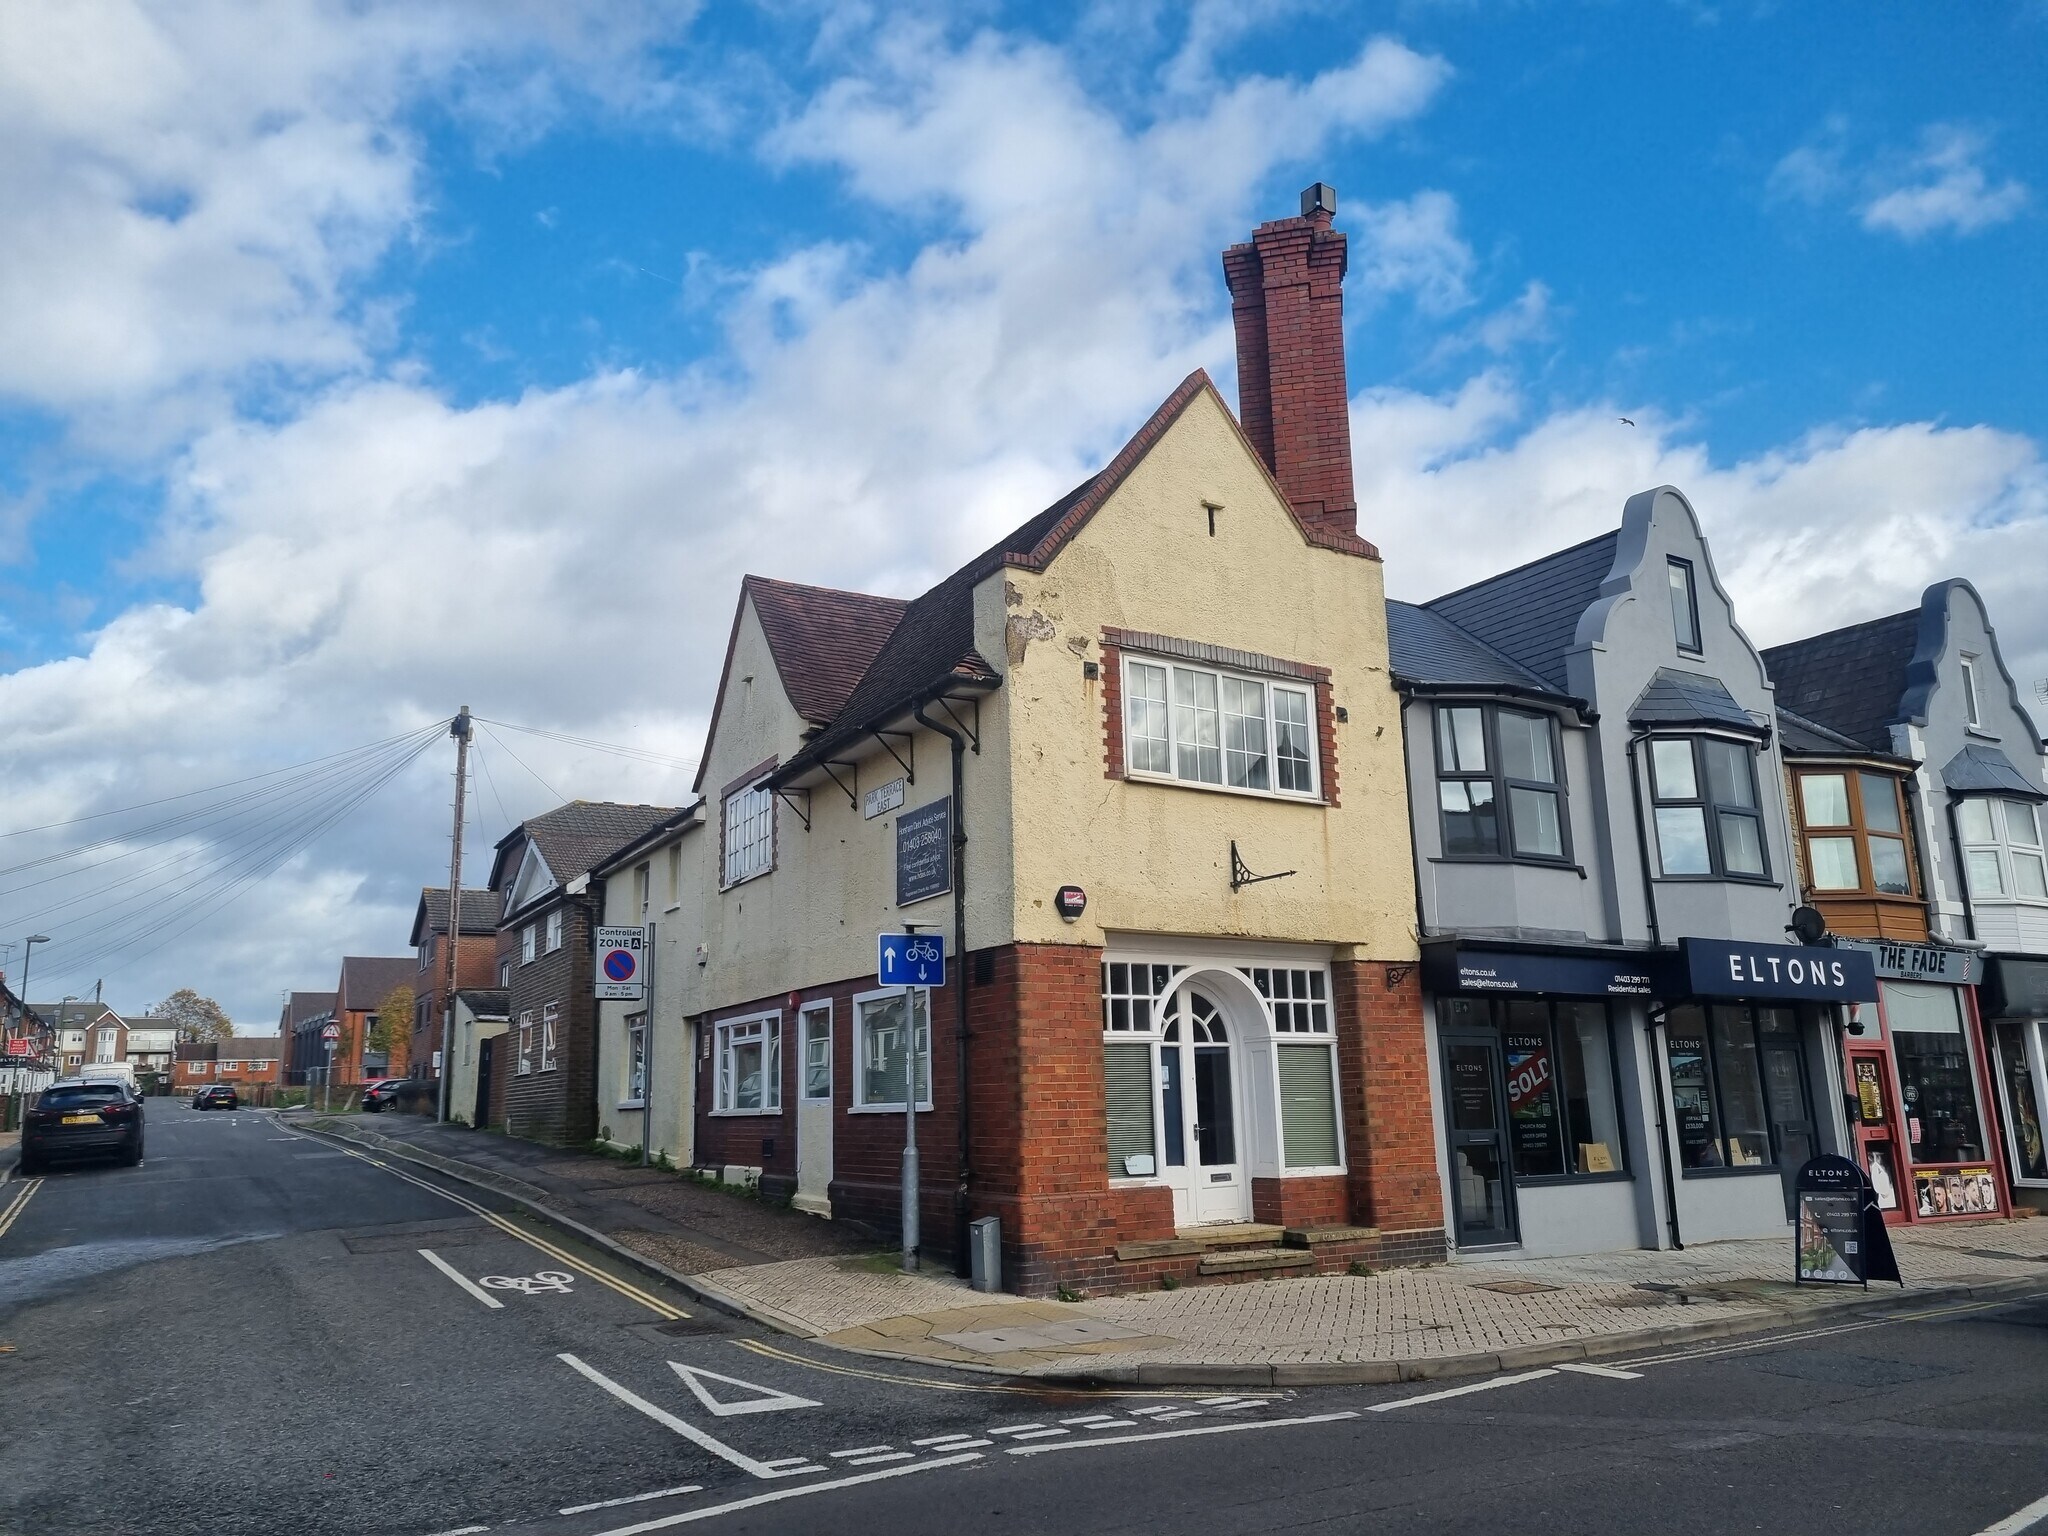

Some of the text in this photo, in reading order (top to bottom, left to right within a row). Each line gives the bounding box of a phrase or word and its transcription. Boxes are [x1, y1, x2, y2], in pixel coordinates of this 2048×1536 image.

[866, 780, 902, 806] PARK TERRACE
[877, 798, 890, 812] EAST
[933, 811, 947, 822] Service
[599, 928, 642, 936] Controlled
[599, 939, 640, 948] ZONE A
[1879, 946, 1947, 974] THE FADE
[1460, 967, 1497, 977] eltons.co.uk
[1729, 954, 1845, 987] ELTONS
[1900, 970, 1922, 979] BARBERS
[1461, 978, 1519, 989] sales@eltons.co.uk
[1614, 975, 1631, 983] 01403
[1631, 975, 1641, 984] 299
[1607, 984, 1651, 994] Residential sales
[1508, 1037, 1543, 1047] ELTONS
[1669, 1040, 1700, 1049] ELTONS
[1508, 1057, 1549, 1102] SOLD
